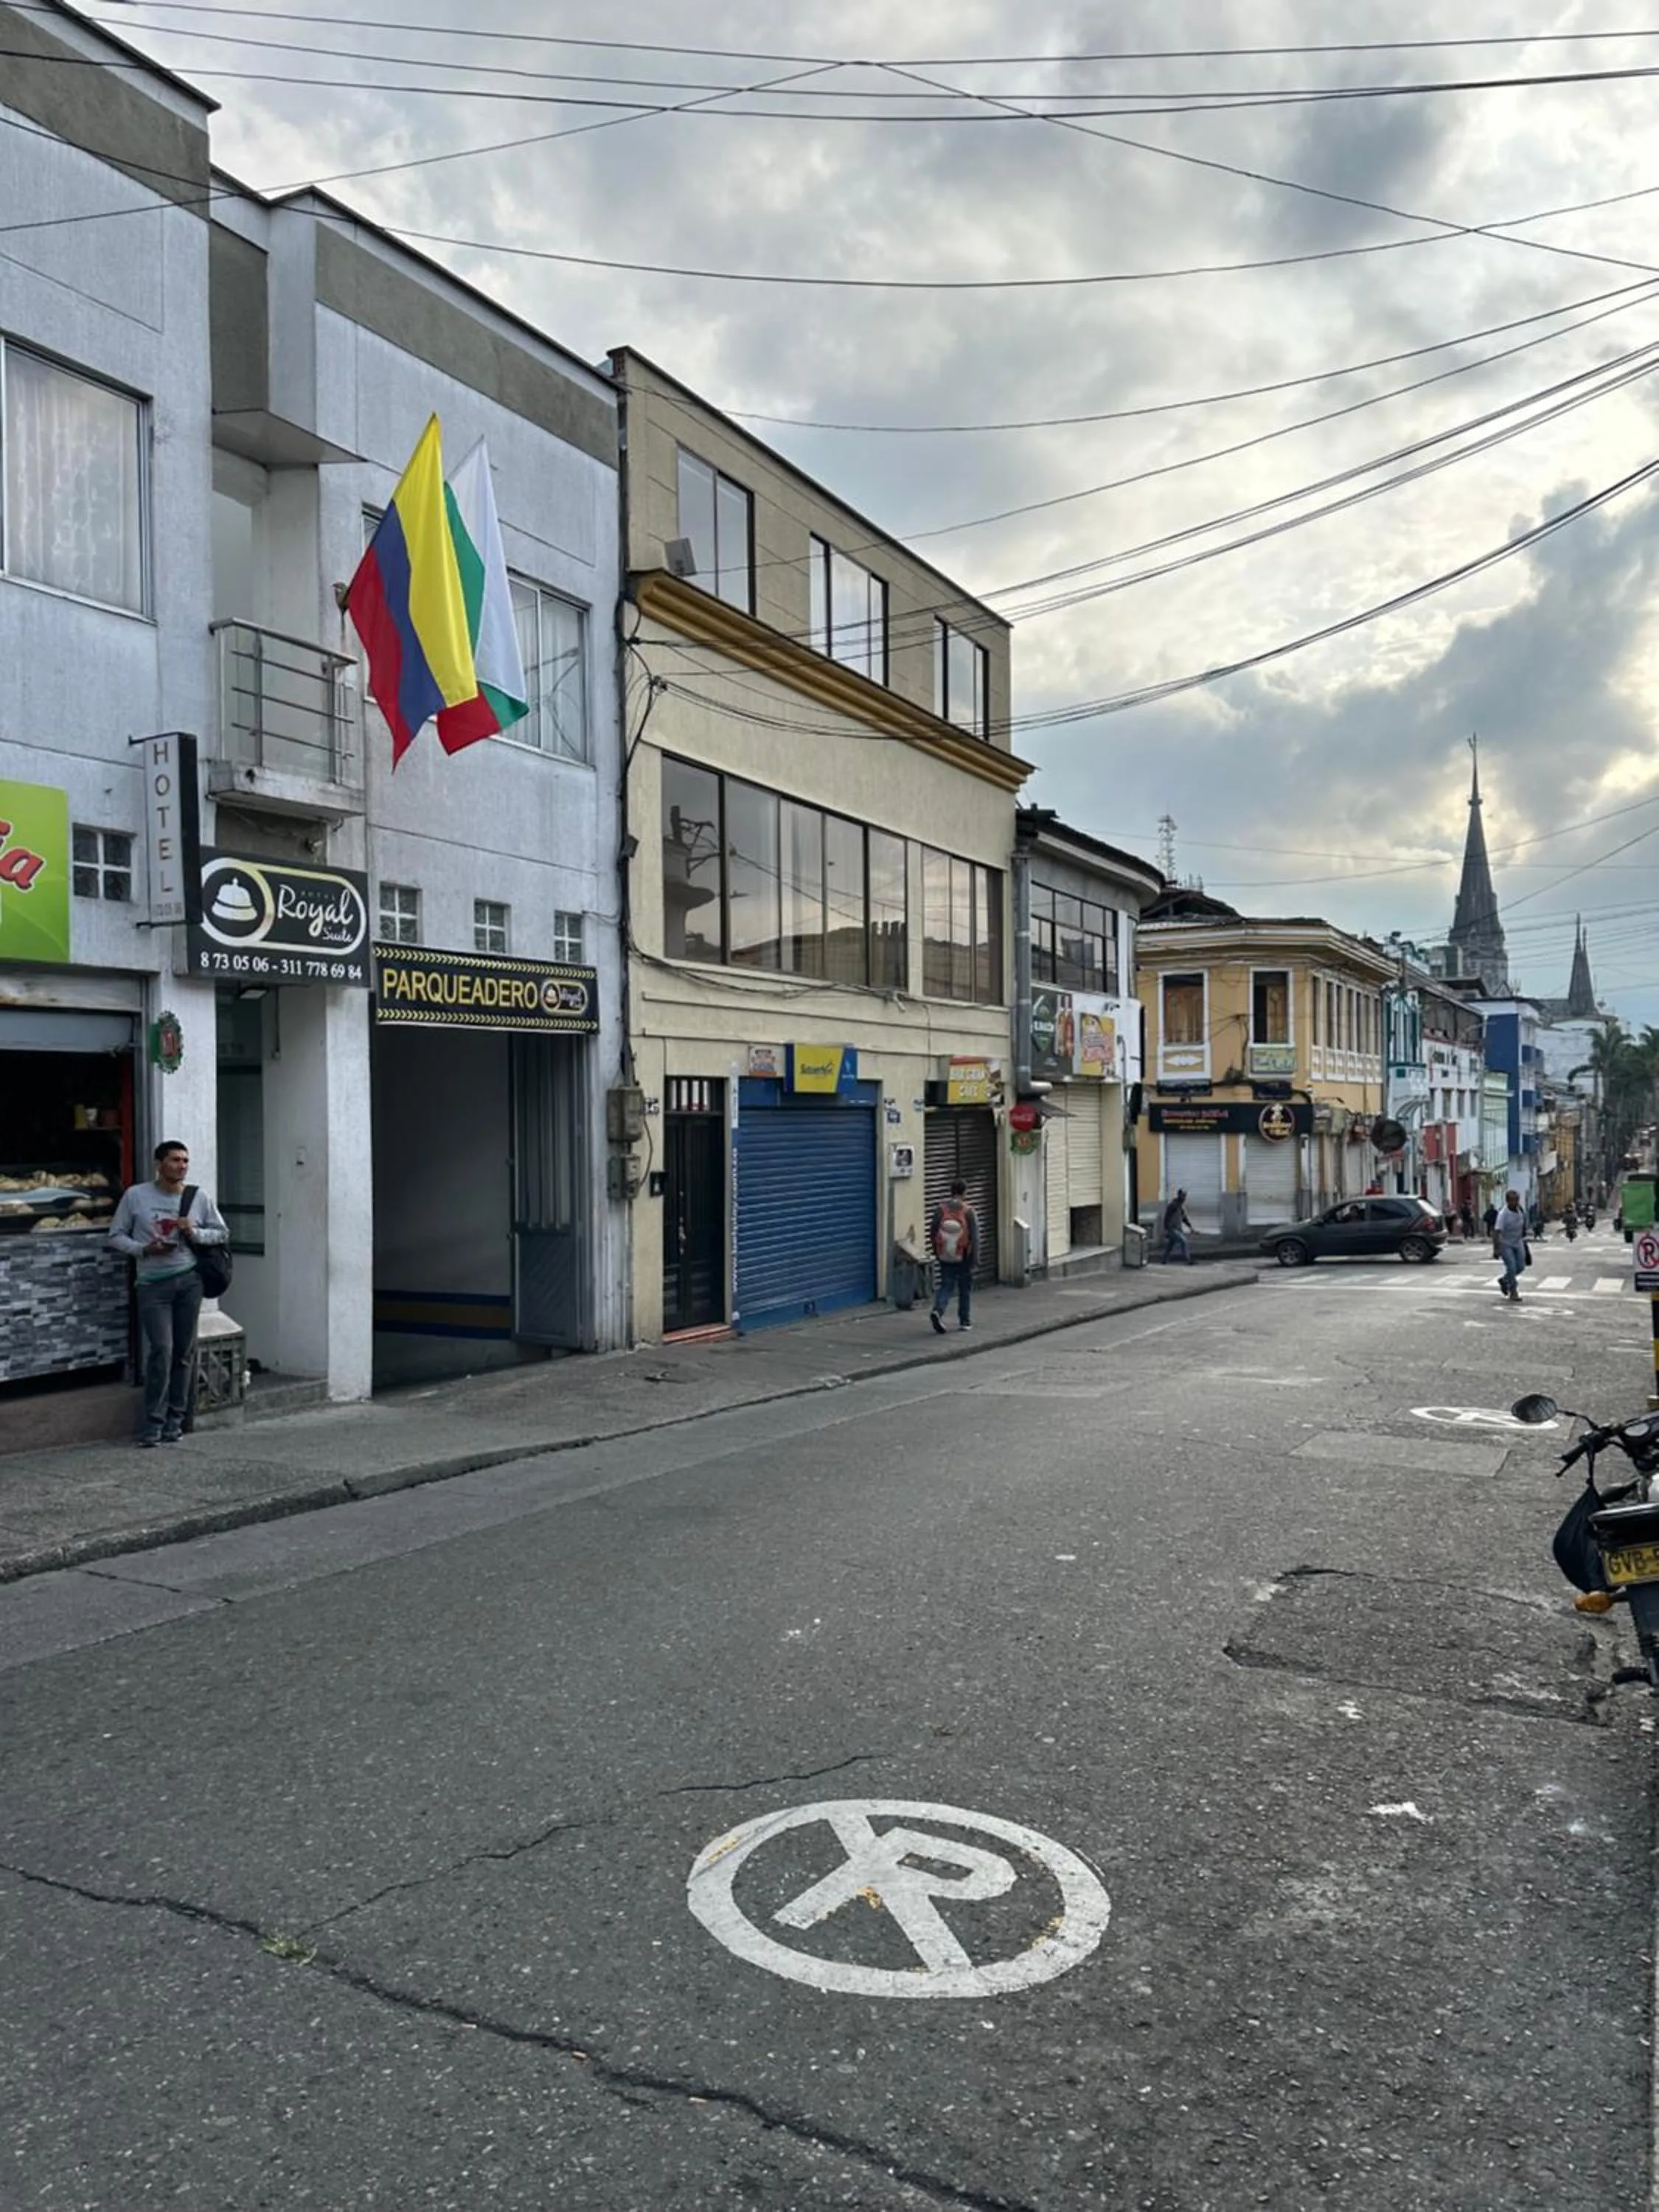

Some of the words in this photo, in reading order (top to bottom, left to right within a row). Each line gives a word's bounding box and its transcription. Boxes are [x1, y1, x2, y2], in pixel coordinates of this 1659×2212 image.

[153, 741, 173, 892] HOTEL
[277, 883, 354, 938] Royal
[201, 951, 209, 967] 8
[212, 953, 229, 970] 73
[233, 954, 249, 971] 05
[252, 956, 269, 973] 06
[280, 959, 302, 975] 311
[306, 961, 328, 977] 778
[331, 963, 346, 979] 69
[347, 964, 362, 980] 84
[382, 967, 538, 1009] PARQUEADERO
